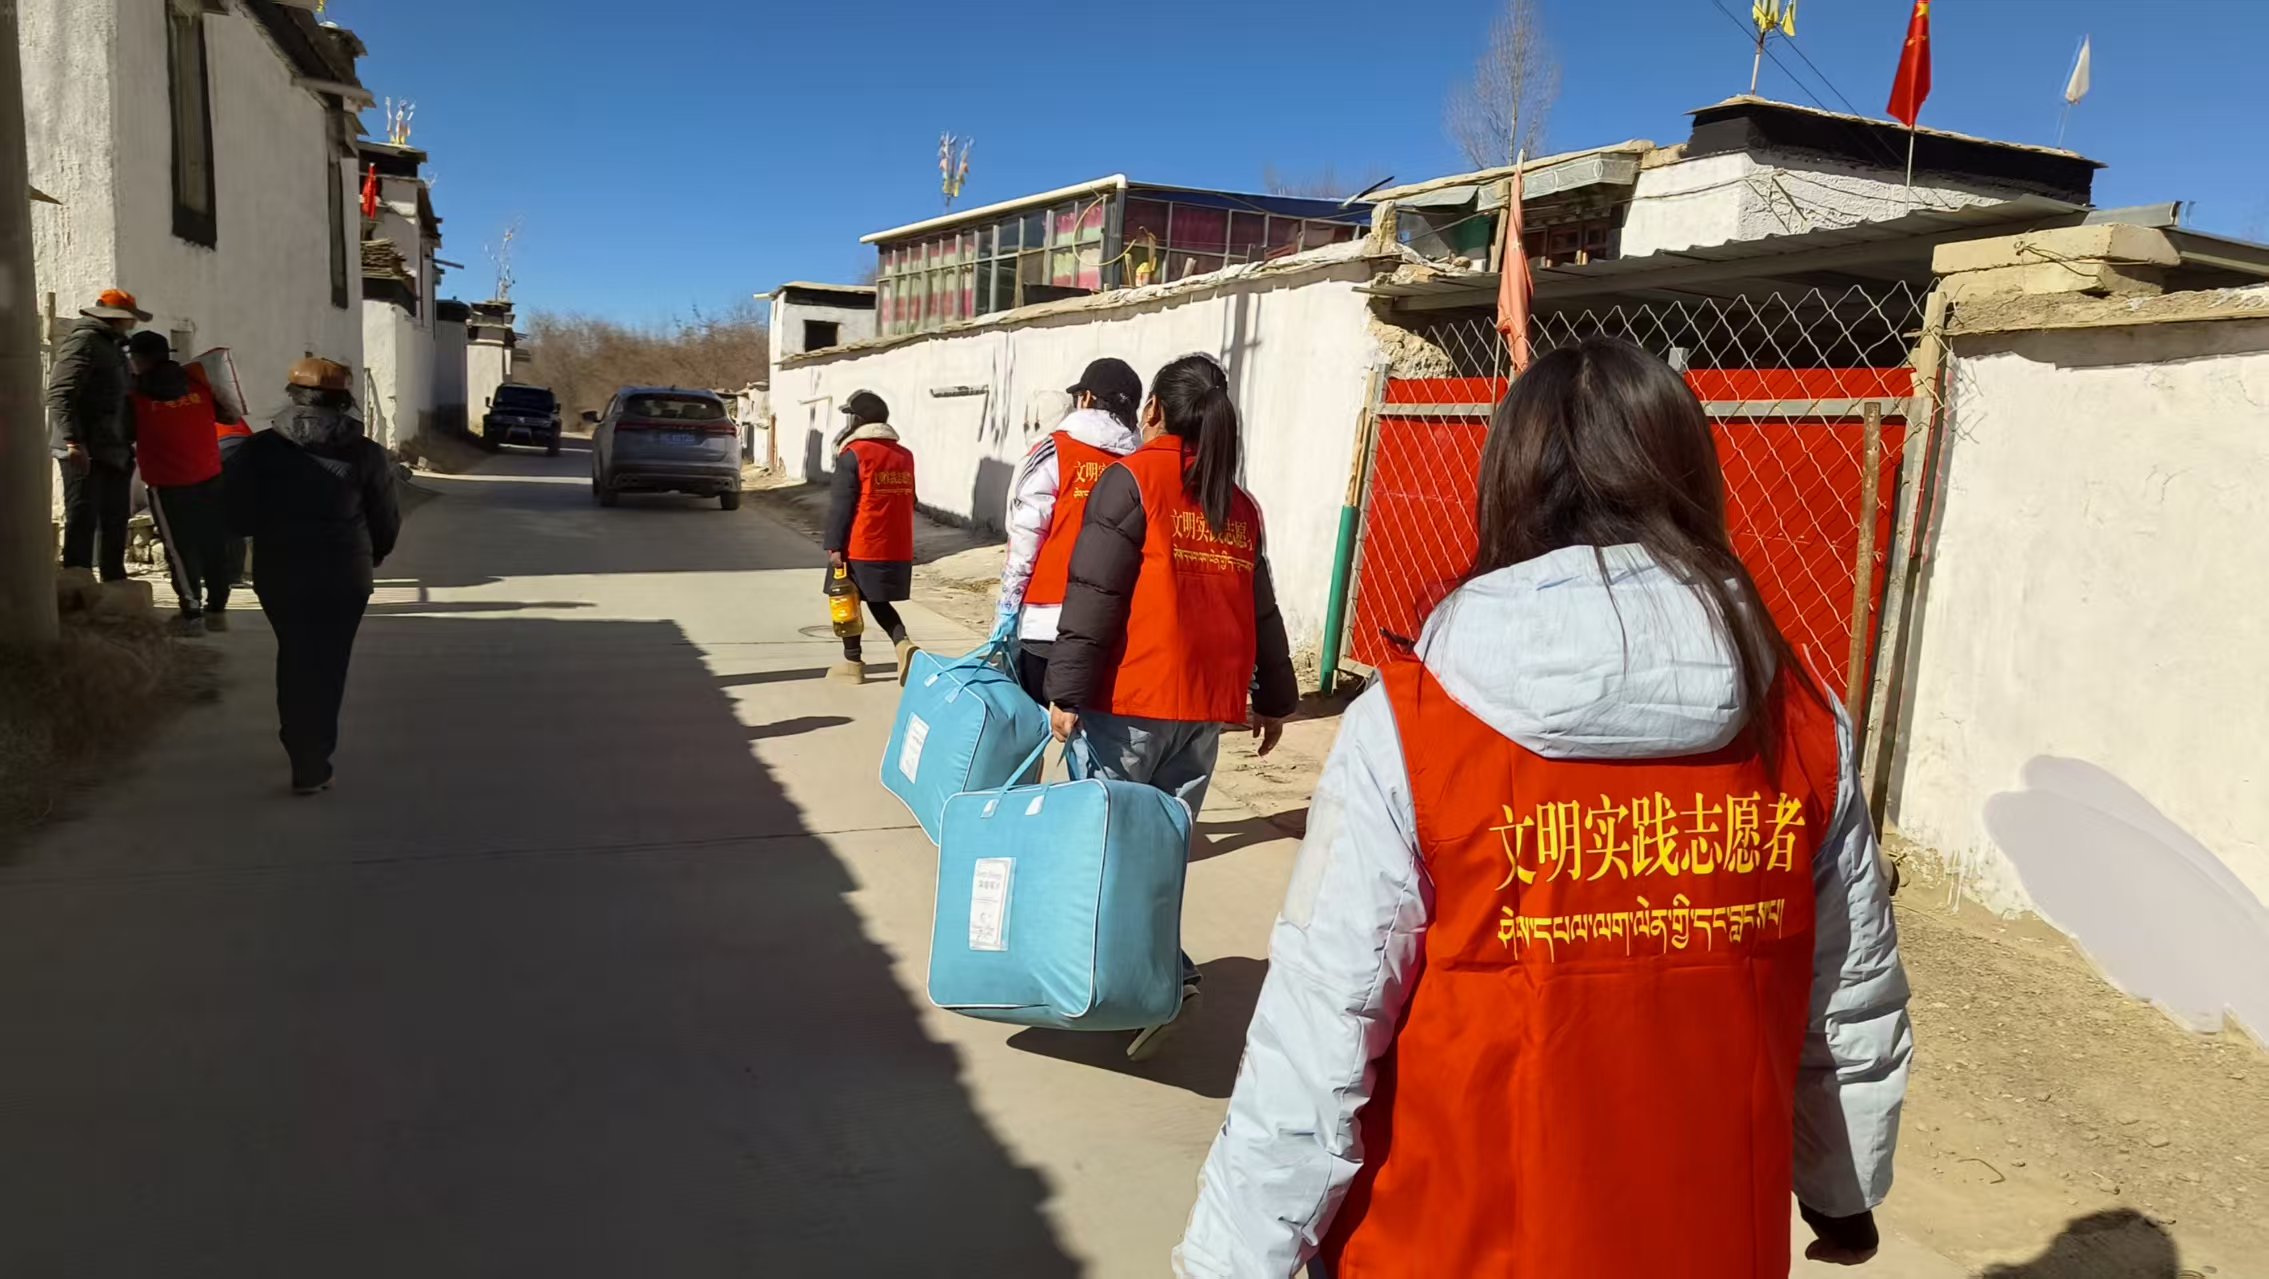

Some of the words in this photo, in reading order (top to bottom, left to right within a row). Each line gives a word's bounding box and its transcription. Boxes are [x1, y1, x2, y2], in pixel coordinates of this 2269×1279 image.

[1489, 791, 1806, 891] 文明实践志愿者
